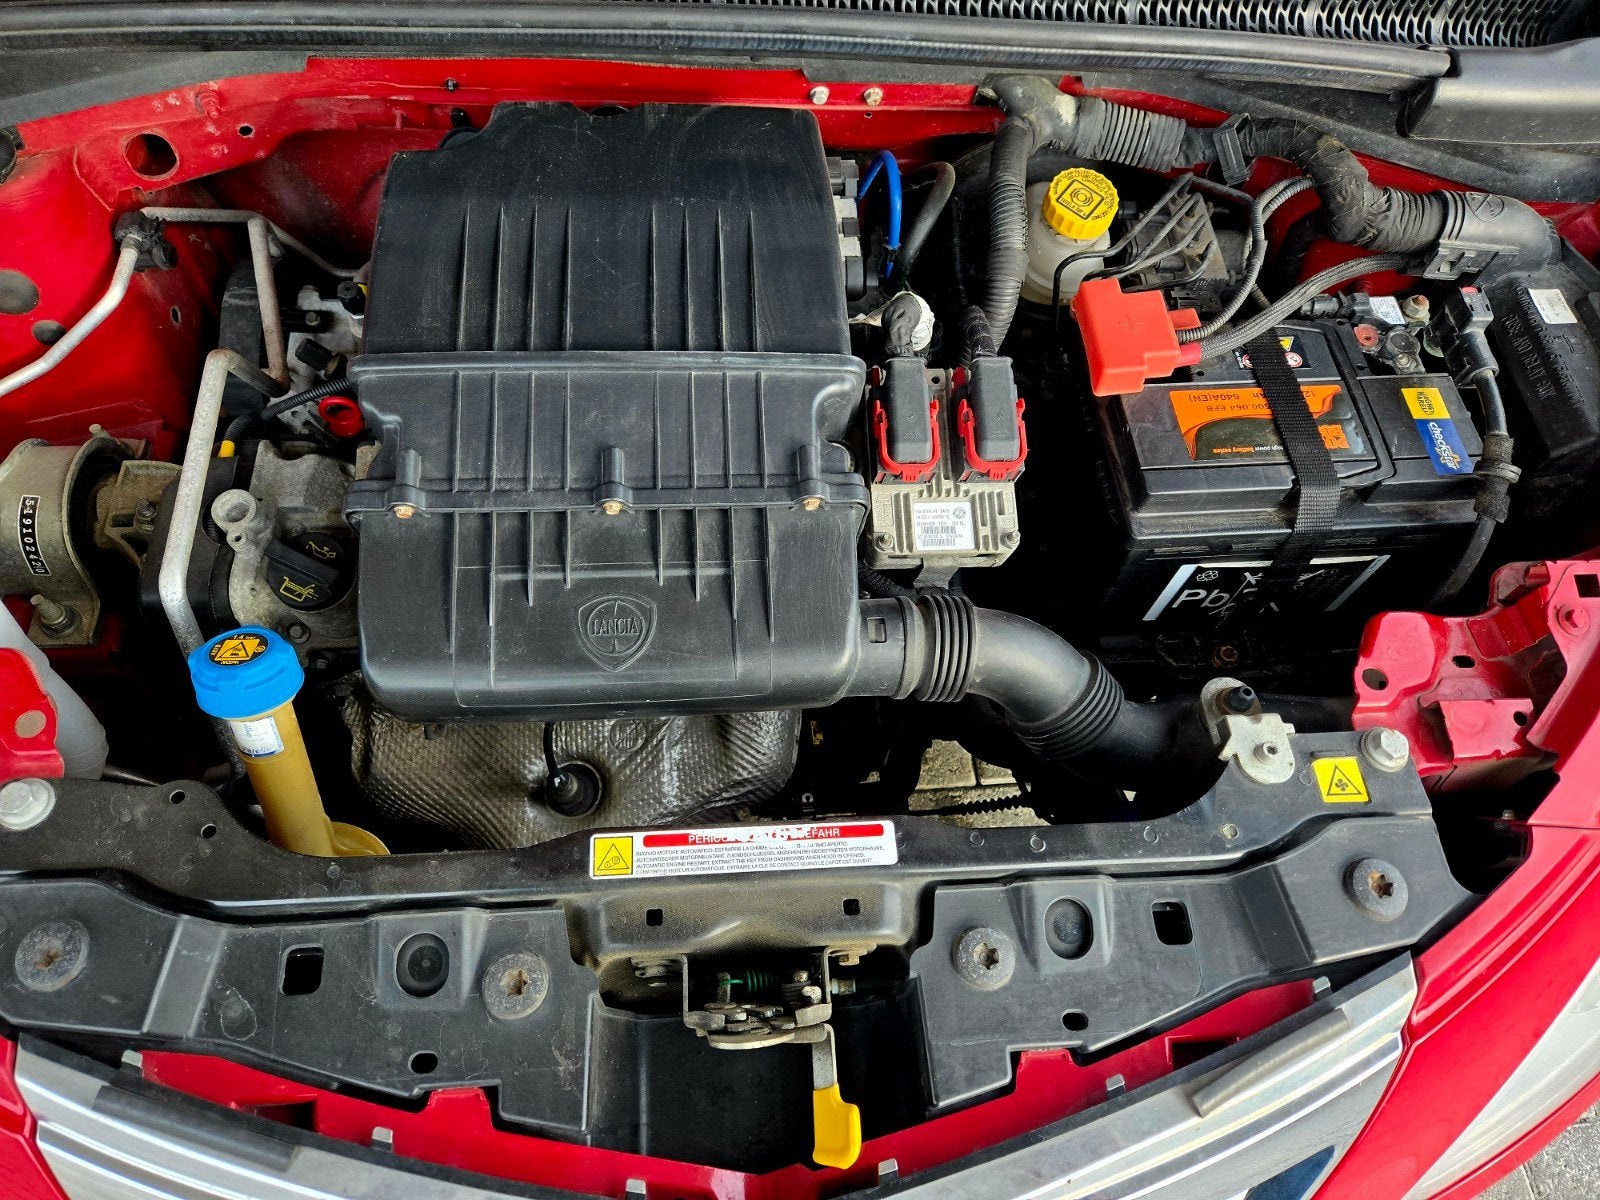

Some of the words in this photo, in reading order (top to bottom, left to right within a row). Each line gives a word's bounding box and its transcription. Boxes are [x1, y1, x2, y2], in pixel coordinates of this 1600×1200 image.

[1188, 392, 1240, 402] 640A(EN)
[1429, 421, 1459, 471] checkstar
[1172, 589, 1231, 609] Pb
[591, 618, 640, 636] LANCIA
